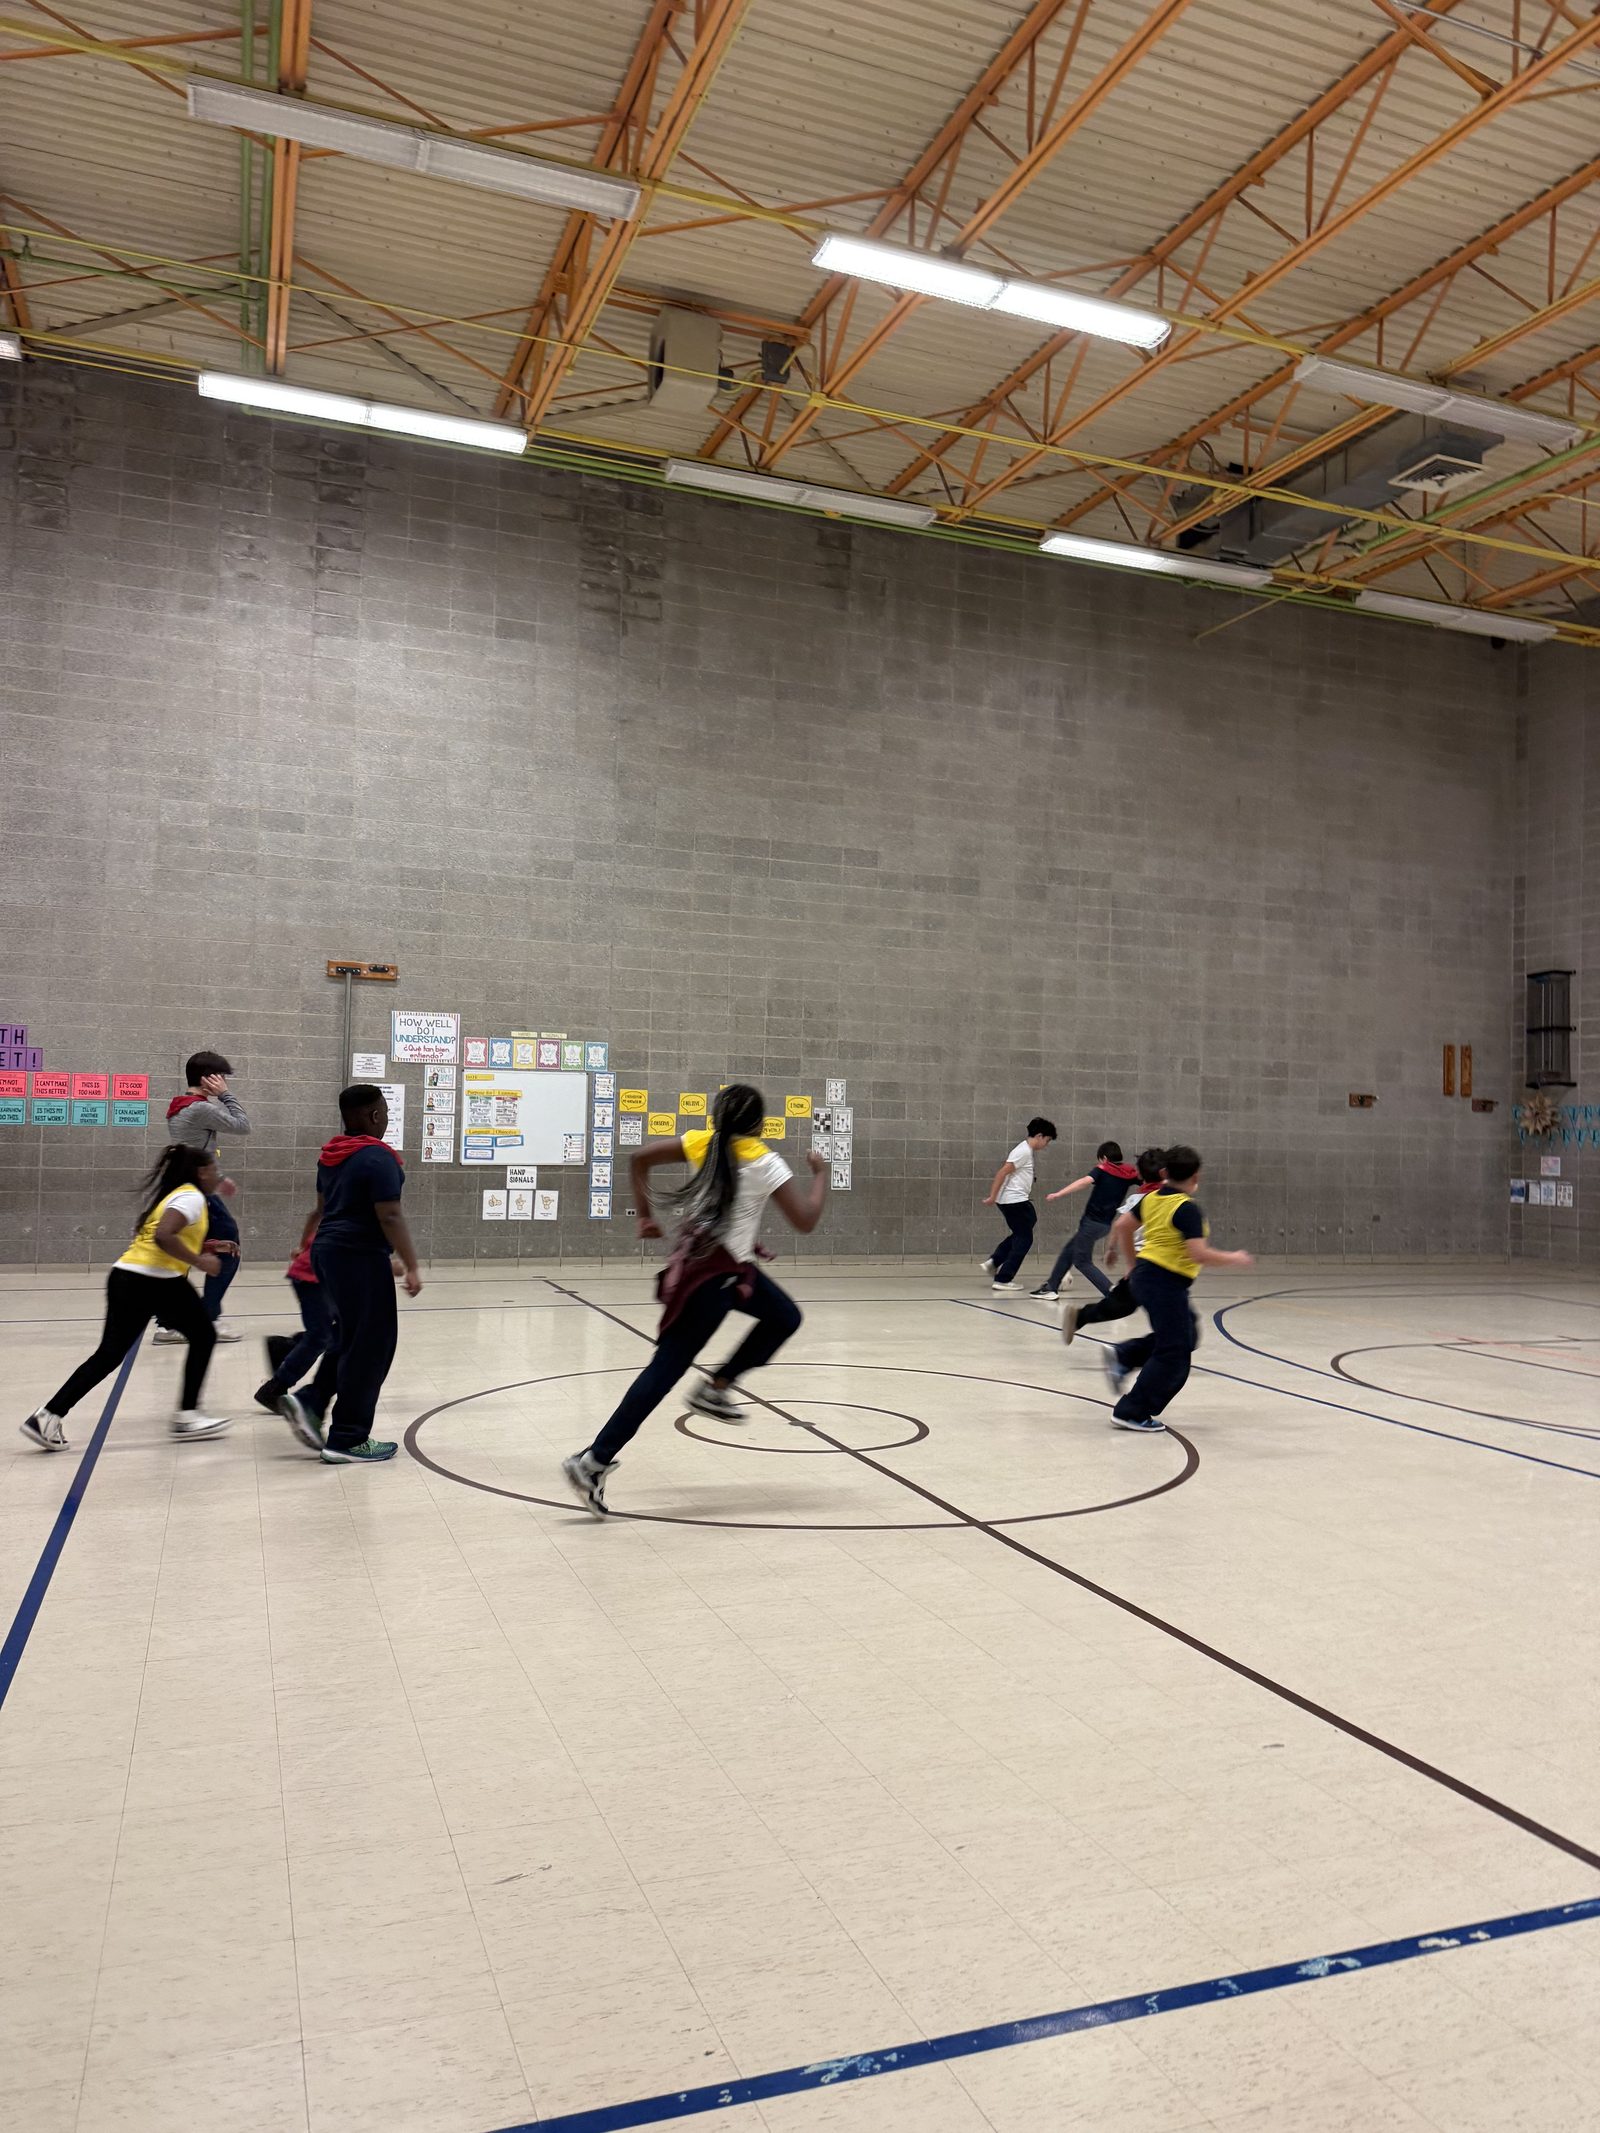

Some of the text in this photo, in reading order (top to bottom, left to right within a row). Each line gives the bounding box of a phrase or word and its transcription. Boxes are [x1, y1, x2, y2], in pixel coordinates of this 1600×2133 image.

[399, 1017, 452, 1029] HOW WELL
[416, 1027, 430, 1035] DO
[395, 1034, 456, 1044] UNDERSTAND?
[435, 1045, 450, 1053] bien
[509, 1168, 526, 1176] HAND
[509, 1176, 535, 1184] SIGNALS
